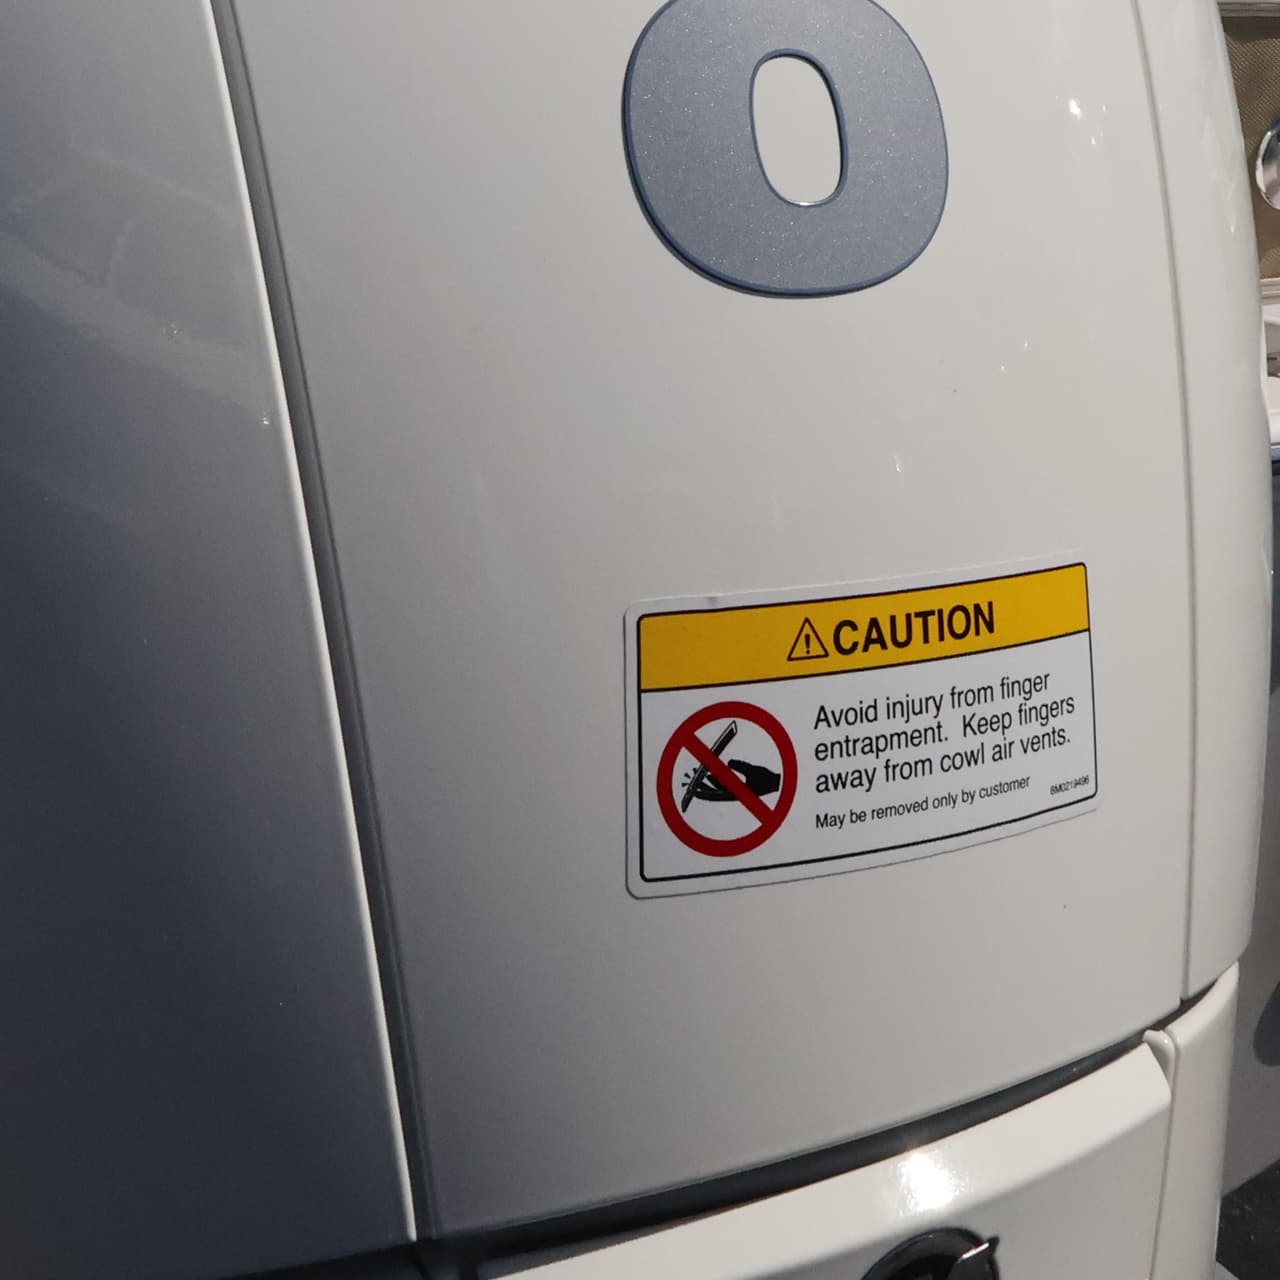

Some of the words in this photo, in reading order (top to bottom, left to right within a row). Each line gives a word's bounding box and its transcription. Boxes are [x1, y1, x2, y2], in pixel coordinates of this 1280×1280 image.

[833, 601, 994, 656] CAUTION
[814, 699, 878, 729] Avoid
[886, 694, 943, 723] injury
[950, 686, 994, 709] from
[1000, 673, 1050, 700] finger
[814, 721, 948, 761] entrapment.
[962, 711, 1013, 737] Keep
[1018, 696, 1075, 727] fingers
[815, 766, 876, 793] away
[884, 756, 933, 782] from
[940, 742, 985, 773] cowl
[992, 737, 1014, 762] air
[1020, 726, 1071, 755] vents.
[815, 811, 846, 829] May
[850, 809, 867, 824] be
[871, 797, 928, 821] removed
[932, 792, 958, 809] only
[961, 786, 976, 804] by
[979, 775, 1030, 799] customer
